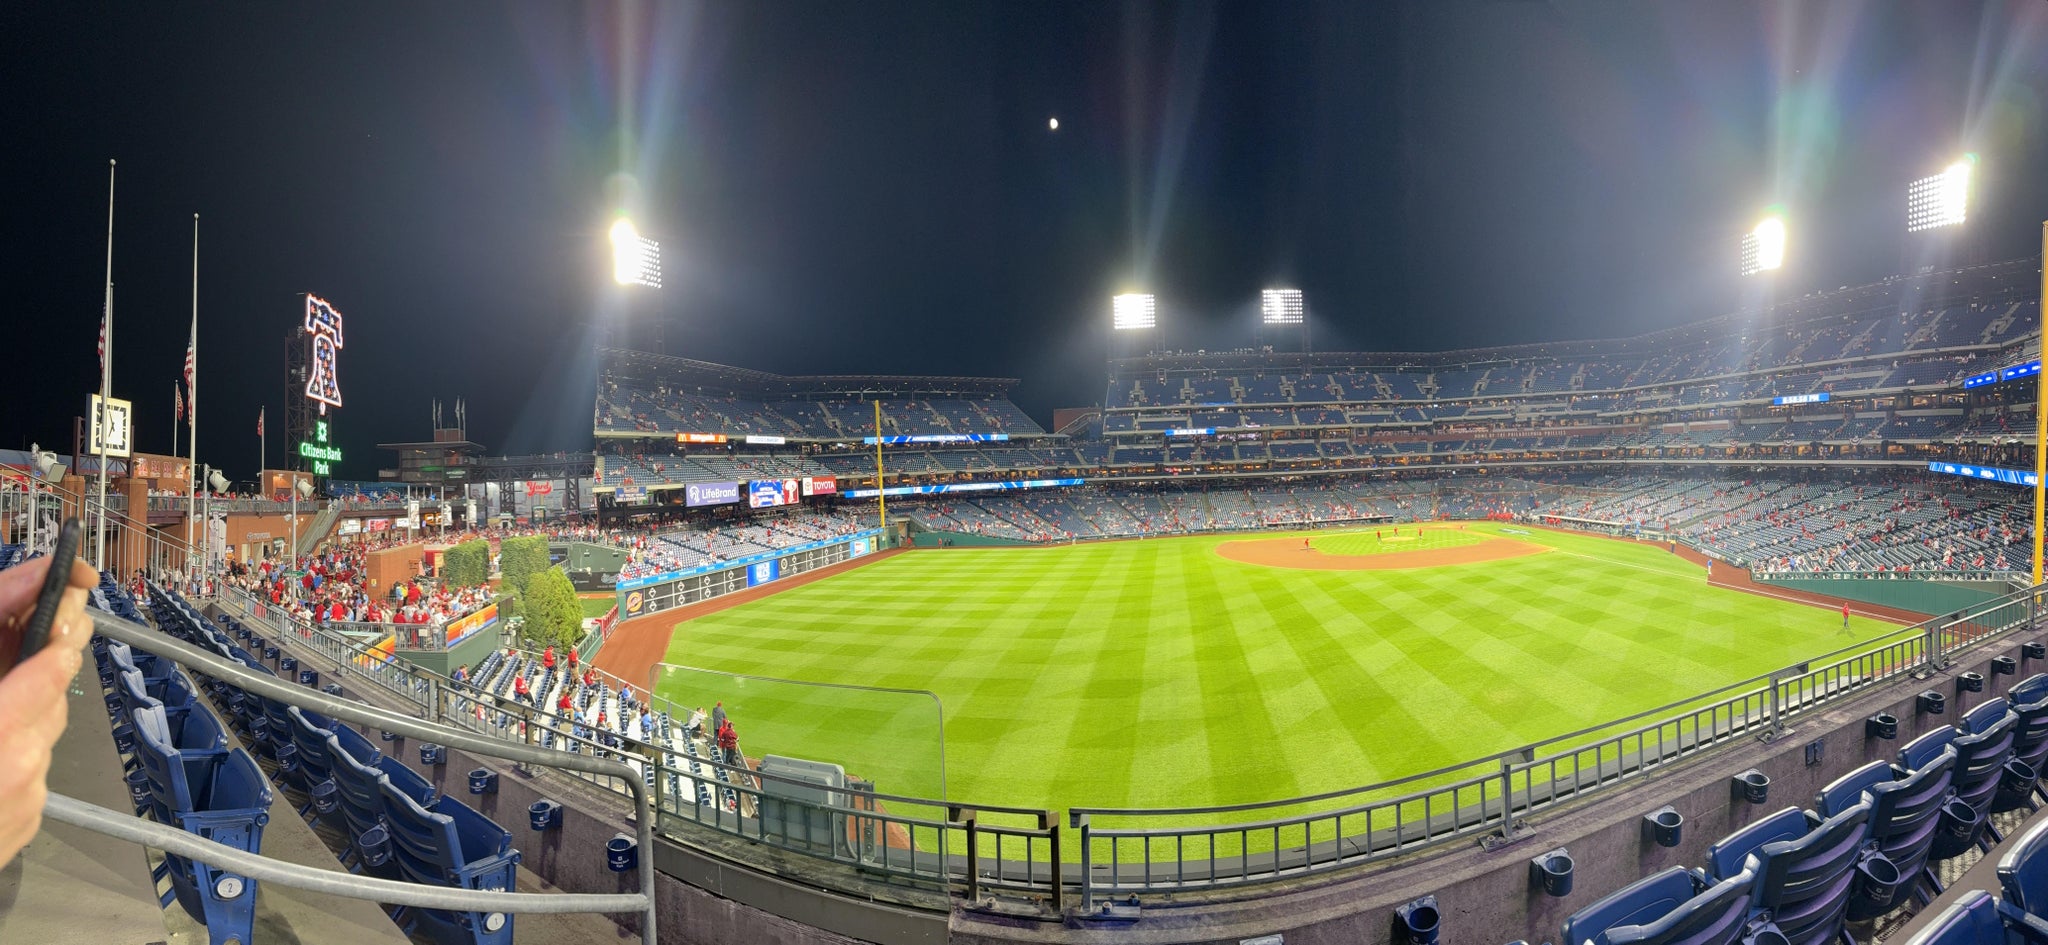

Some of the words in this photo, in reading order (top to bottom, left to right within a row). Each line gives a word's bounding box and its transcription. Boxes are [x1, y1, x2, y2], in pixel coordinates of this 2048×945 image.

[301, 442, 327, 459] Citizens
[327, 446, 342, 461] Bank
[315, 460, 329, 475] Park
[526, 480, 552, 497] Yard
[701, 486, 737, 499] LifeBrand
[813, 481, 835, 490] TOYOTA
[228, 882, 233, 893] 2
